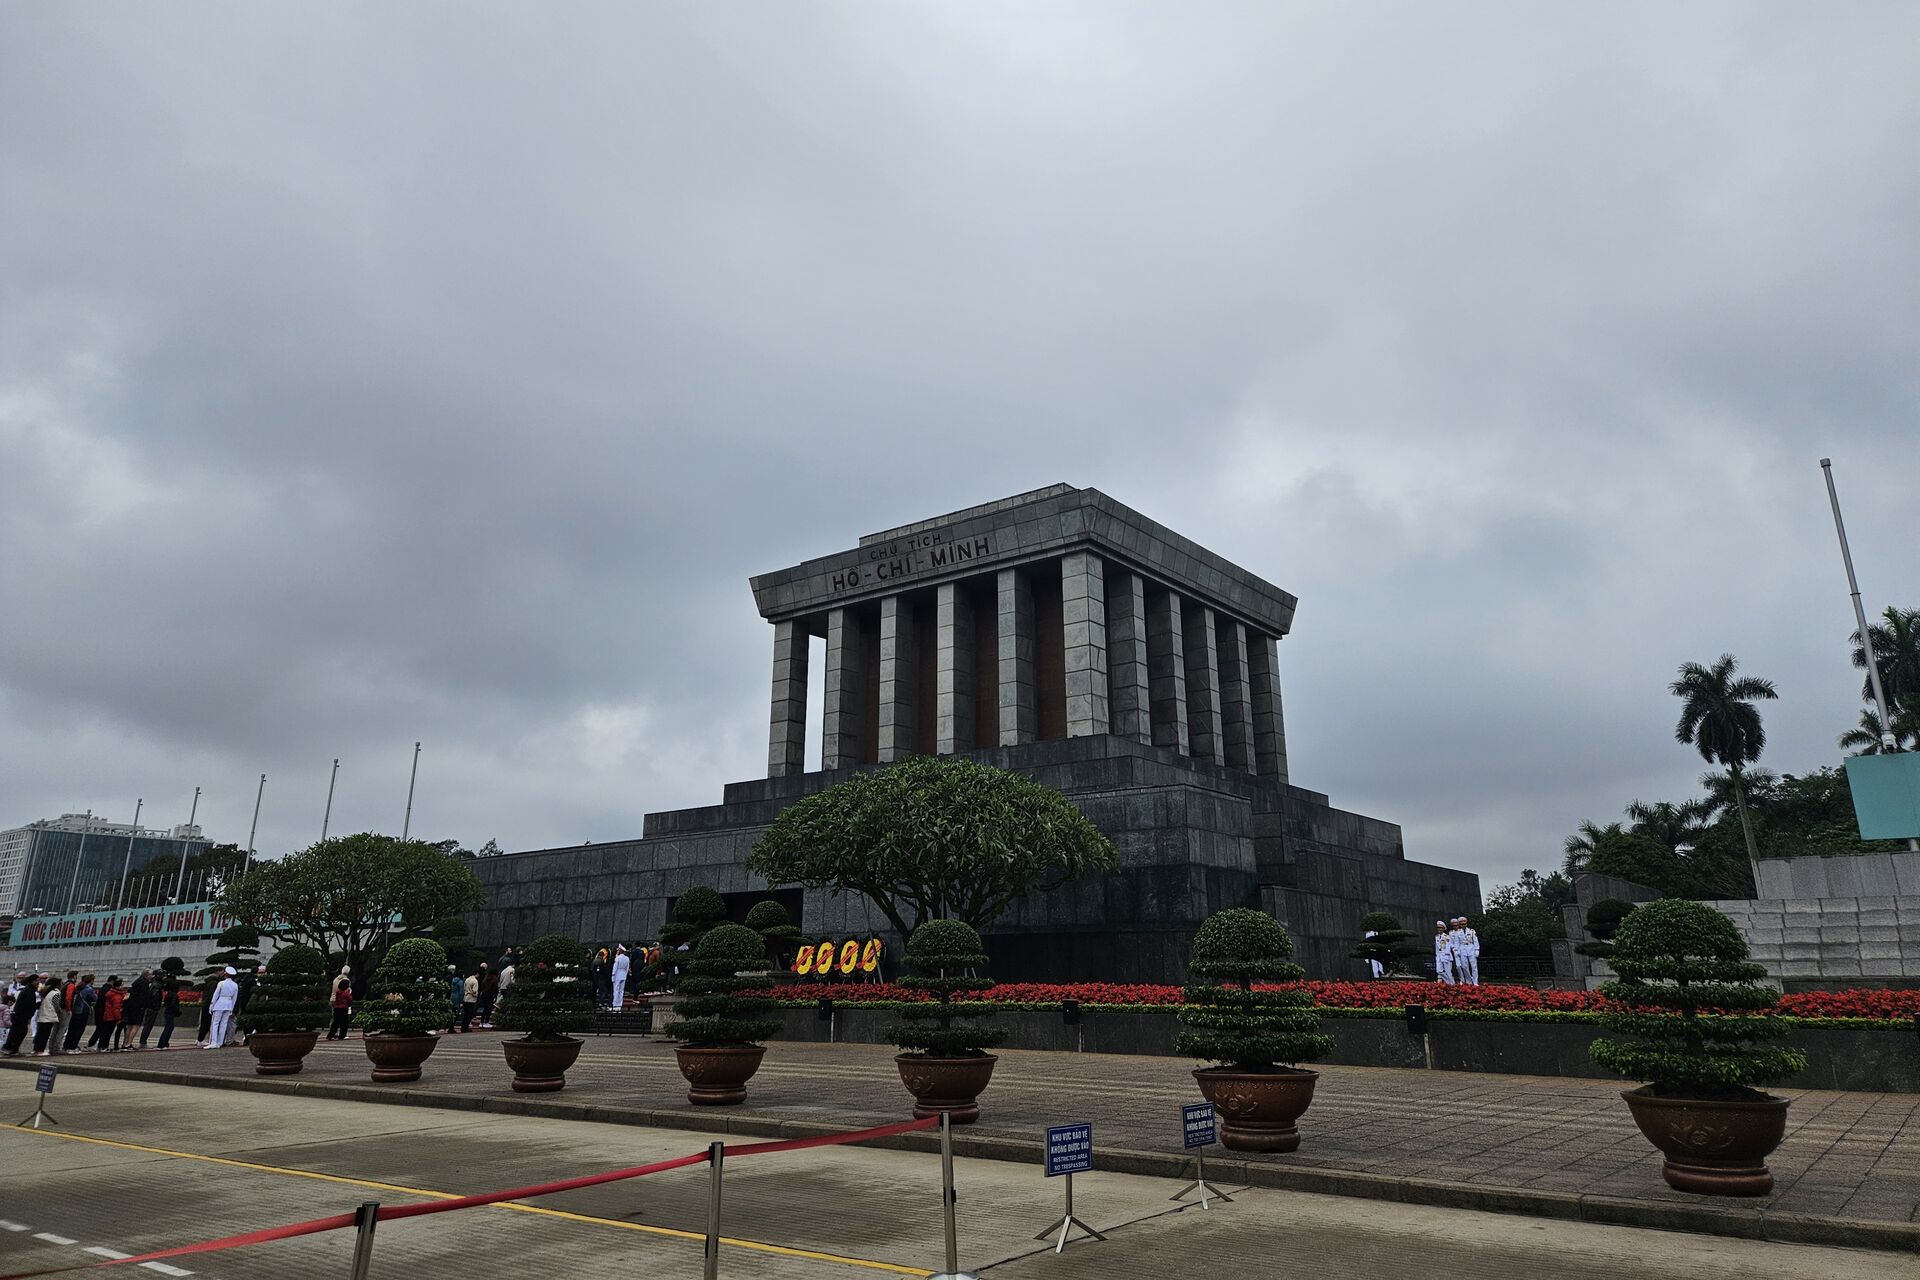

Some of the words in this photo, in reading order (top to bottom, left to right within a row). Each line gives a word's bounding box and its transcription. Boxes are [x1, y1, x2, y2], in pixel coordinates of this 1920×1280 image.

[22, 920, 47, 941] NƯỚC
[49, 918, 75, 942] CỘNG
[77, 915, 98, 938] HÒA
[100, 913, 116, 937] XÃ
[118, 912, 138, 938] HỘI
[140, 907, 165, 934] CHỦ
[167, 906, 205, 932] NGHĨA
